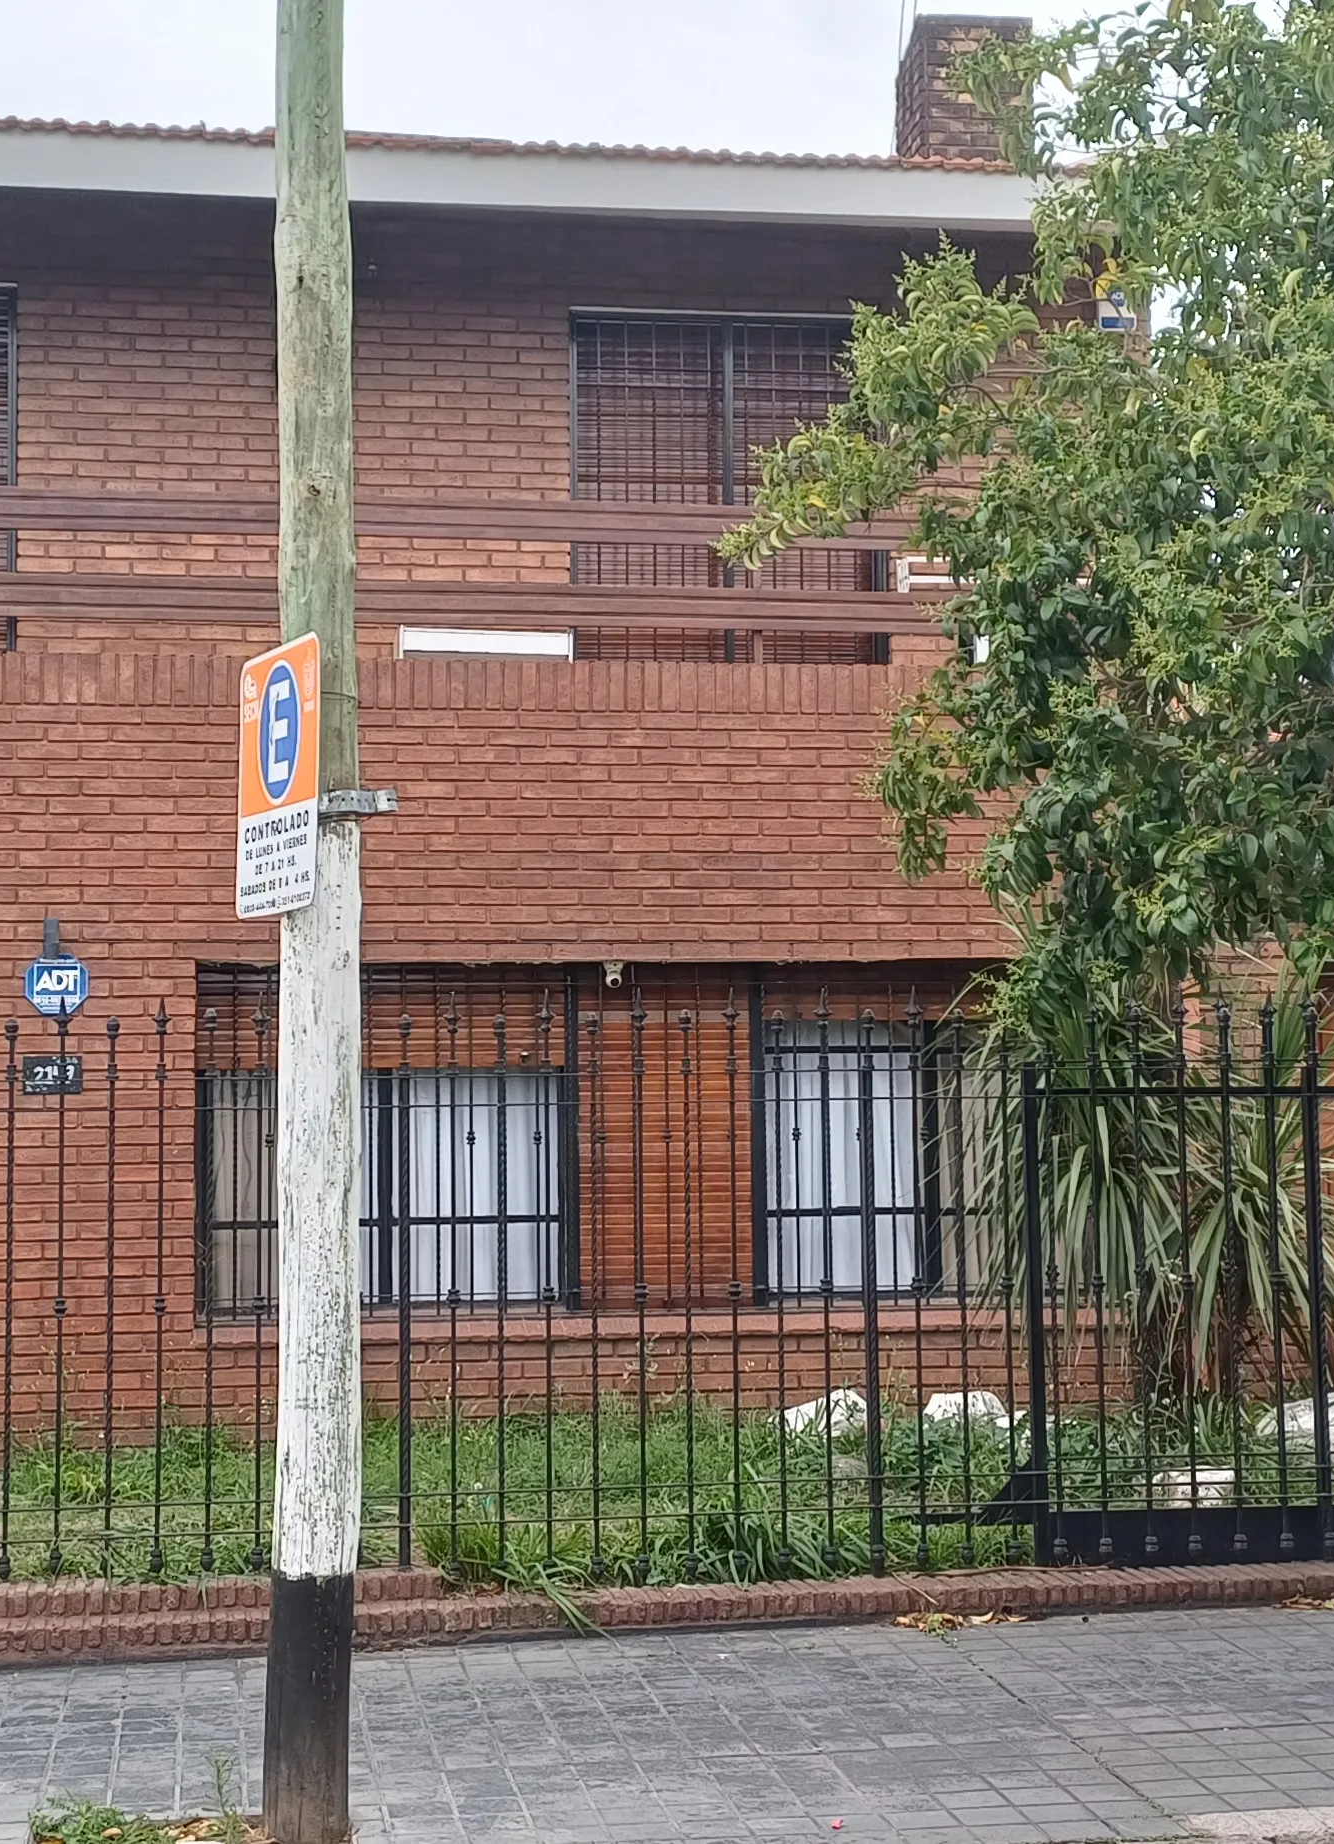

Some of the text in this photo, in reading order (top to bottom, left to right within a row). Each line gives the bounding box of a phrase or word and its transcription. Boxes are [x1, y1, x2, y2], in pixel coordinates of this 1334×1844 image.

[267, 679, 291, 784] E
[244, 810, 309, 844] CONTROLADO
[245, 833, 308, 861] DE LUNES A VIERNES
[254, 863, 263, 876] DE
[270, 860, 275, 871] A
[240, 881, 266, 897] SABADOS
[268, 878, 276, 891] DE
[284, 875, 289, 887] A
[35, 969, 78, 992] ADT
